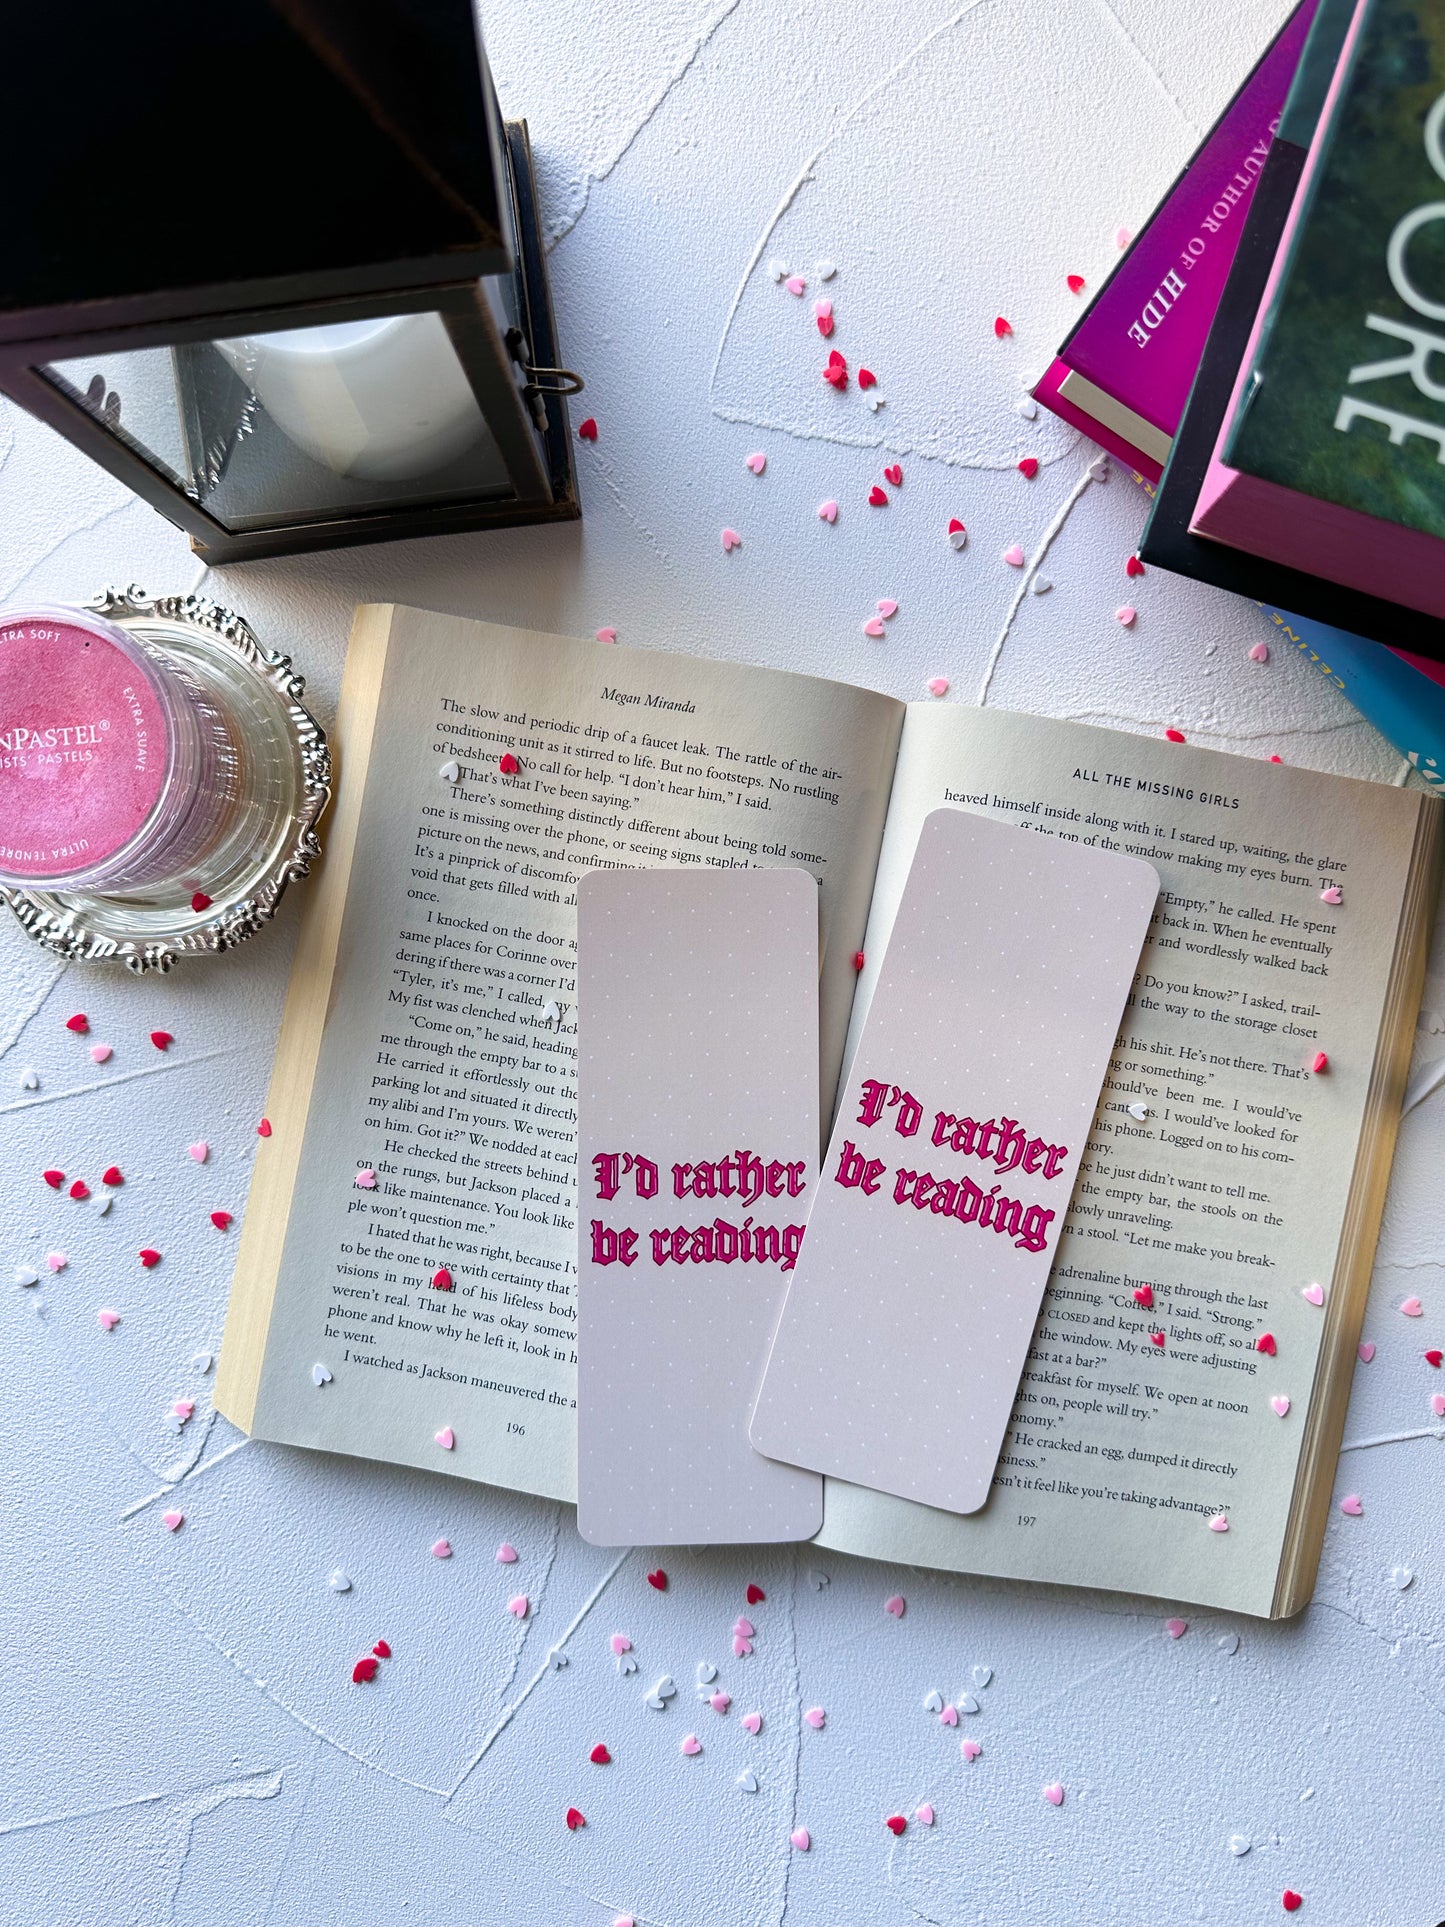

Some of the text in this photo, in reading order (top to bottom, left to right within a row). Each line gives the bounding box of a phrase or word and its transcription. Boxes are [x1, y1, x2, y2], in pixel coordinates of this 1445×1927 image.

[1127, 139, 1270, 349] AUTHOR OF HIDE
[30, 629, 61, 643] SOFT
[600, 687, 696, 714] Megan Miranda
[122, 686, 148, 773] EXTRA SUAVE
[440, 697, 843, 780] The slow and periodic drip of a faucet leak. The rattle of the air-
[38, 749, 94, 765] PASTELS
[436, 720, 840, 806] conditioning unit as it stirred to life. But no footsteps. No rustling
[1072, 768, 1240, 810] ALL THE MISSING GIRLS
[450, 784, 827, 864] There’s something distinctly different about being told some-
[944, 788, 1348, 872] heaved himself inside along with it. I stared up, waiting, the glare
[0, 839, 90, 861] ULTRA TENDRE
[410, 868, 560, 903] void that gets filled with
[1160, 890, 1337, 935] “Empty,” he called. He spent
[399, 930, 577, 970] same places for Corinne over
[408, 1014, 453, 1033] “Come
[455, 1026, 483, 1039] on,”
[484, 1027, 500, 1042] he
[502, 1033, 529, 1049] said,
[1129, 1036, 1310, 1080] his shit. He’s not there. That’s
[371, 1075, 420, 1095] parking
[423, 1080, 441, 1096] lot
[443, 1088, 467, 1100] and
[470, 1090, 519, 1110] situated
[521, 1099, 531, 1112] it
[364, 1117, 552, 1160] on him. Got it?” We nodded at
[857, 1079, 1068, 1180] I’d rather
[1094, 1120, 1295, 1163] his phone. Logged on to his com-
[592, 1150, 806, 1207] I’d rather
[835, 1141, 1055, 1252] be reading
[347, 1199, 496, 1234] ple won’t question me.”
[591, 1216, 806, 1272] be reading
[1077, 1227, 1276, 1268] a stool. “Let me make you break-
[332, 1285, 529, 1334] weren’t real. That he was okay
[1075, 1375, 1249, 1414] for myself. We open at noon
[506, 1422, 526, 1436] 196
[1023, 1476, 1231, 1517] it feel like you’re taking advantage?”
[1018, 1515, 1037, 1527] 197
